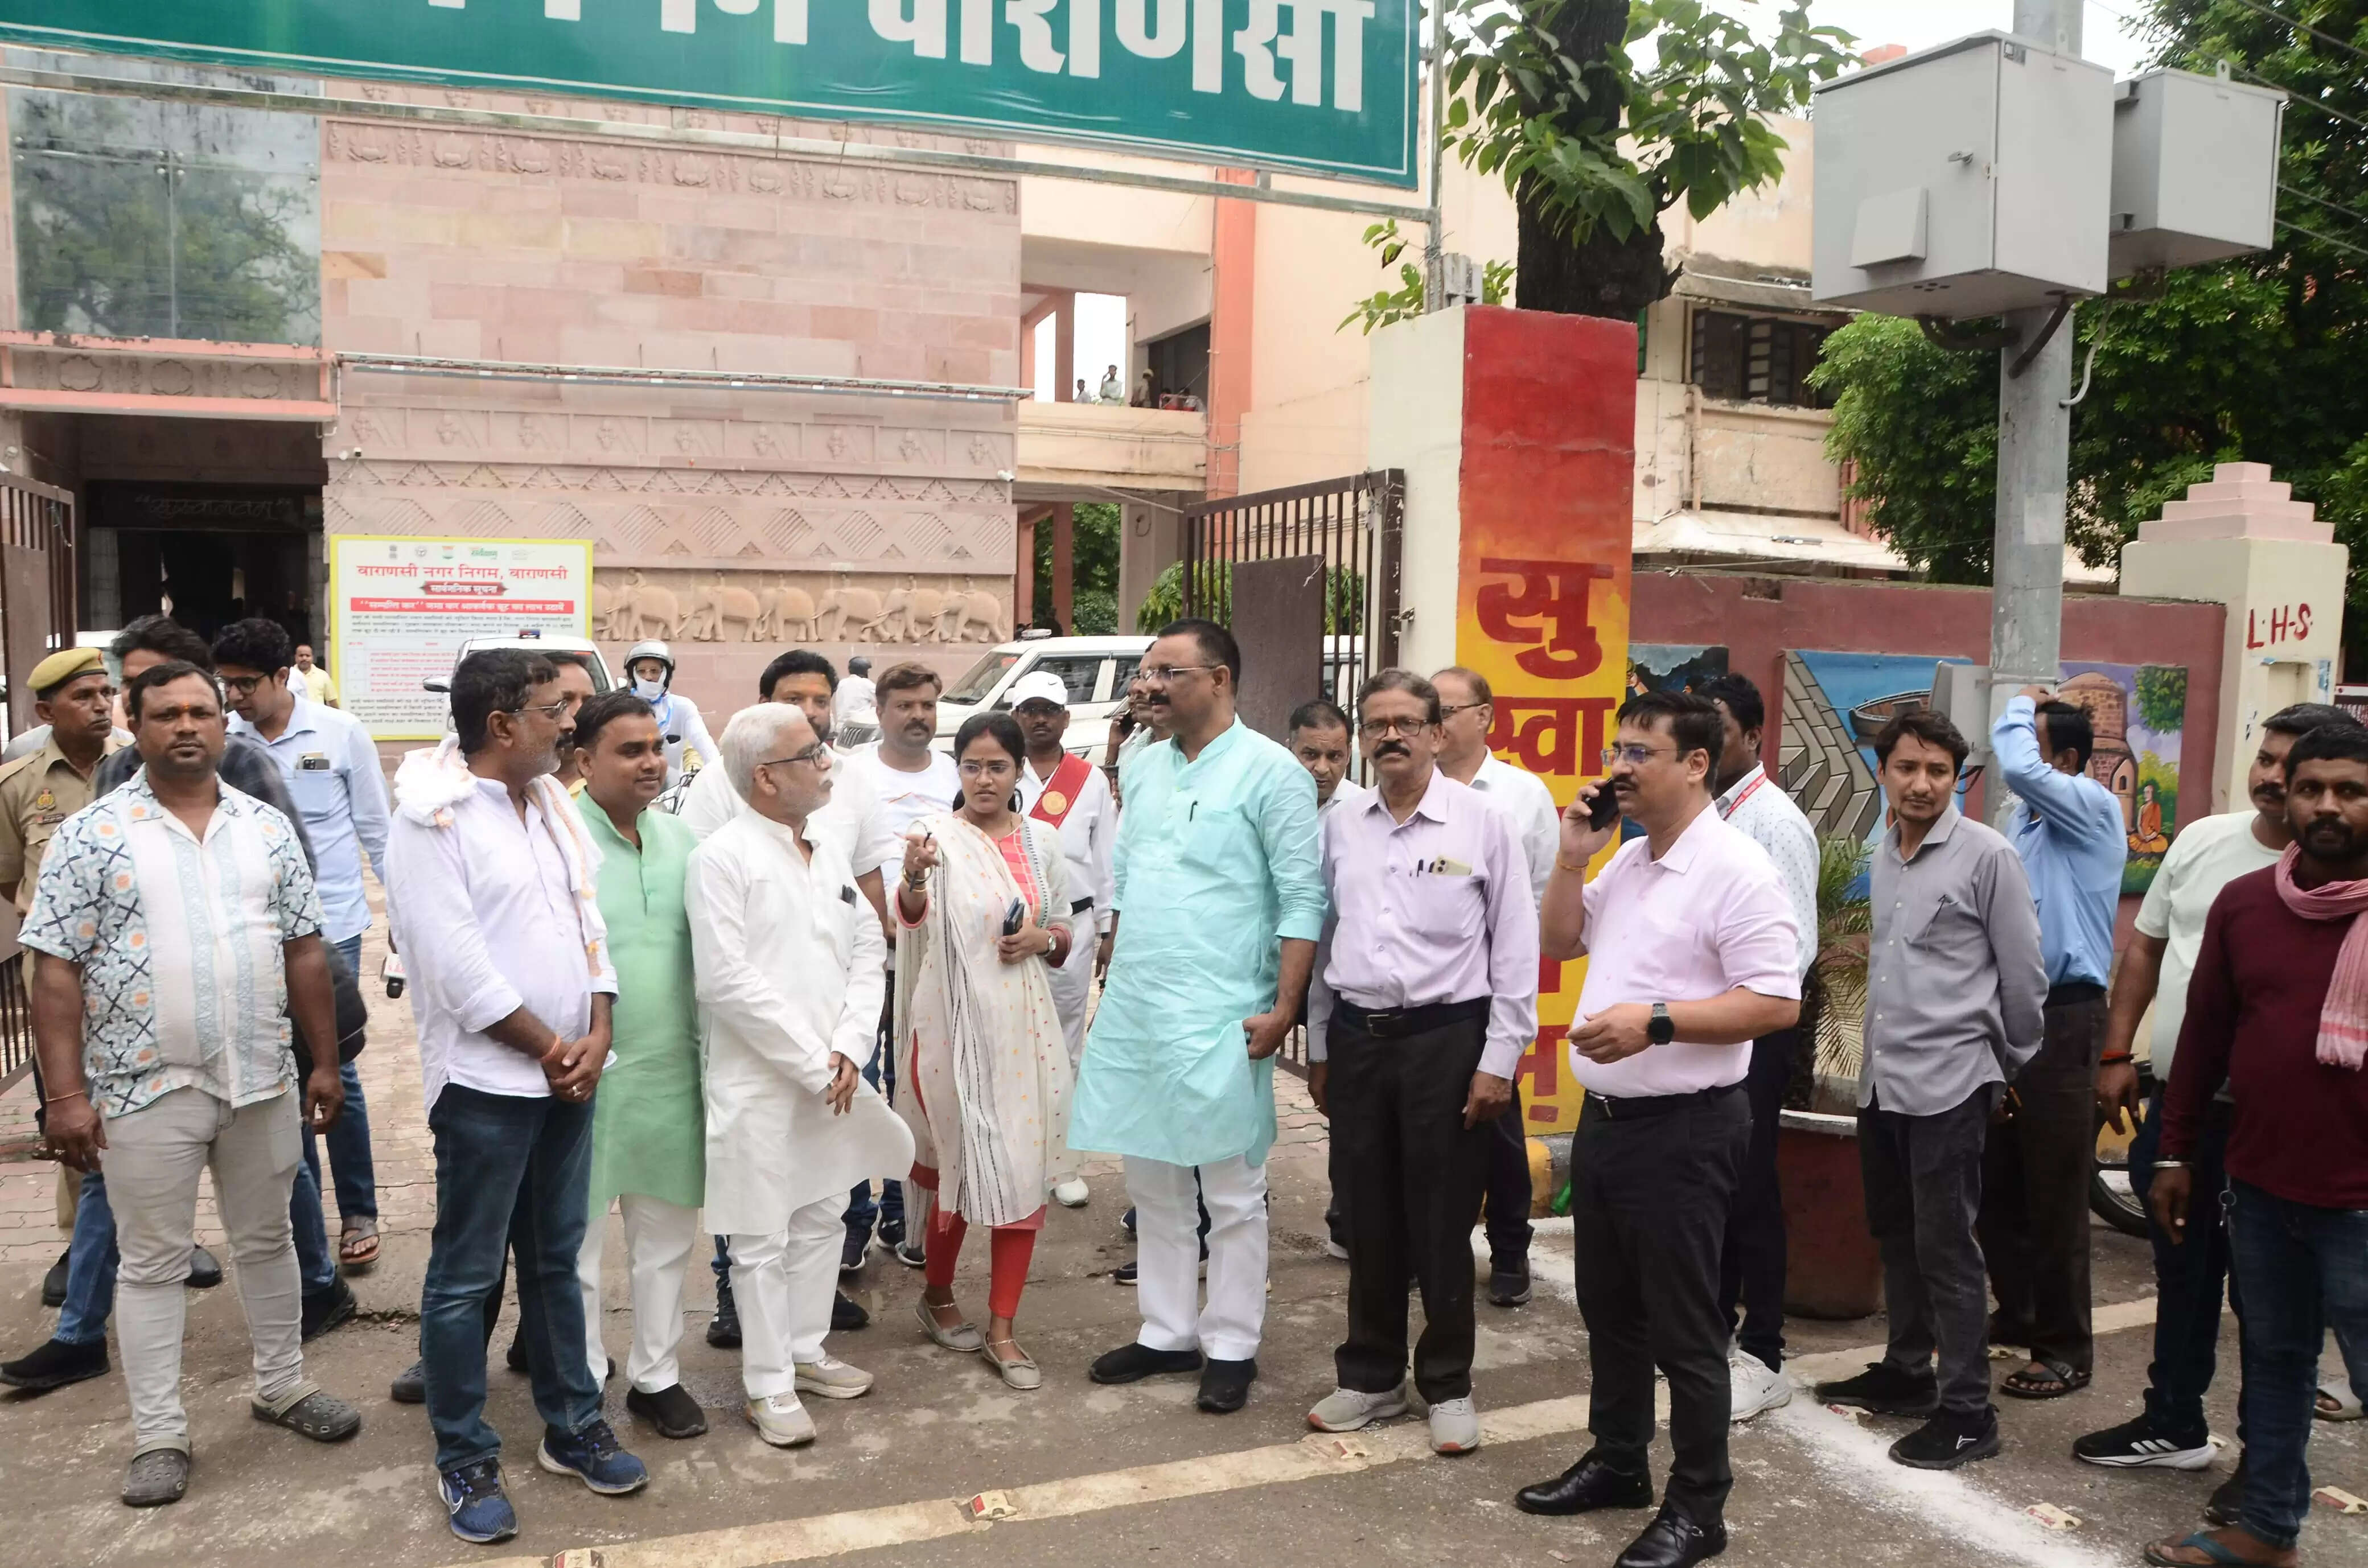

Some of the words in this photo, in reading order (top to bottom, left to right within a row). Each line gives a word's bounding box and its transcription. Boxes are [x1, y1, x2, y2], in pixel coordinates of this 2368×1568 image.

[356, 563, 418, 577] वाराणसी
[423, 567, 454, 578] नगर
[459, 563, 503, 579] निगम,
[509, 566, 569, 579] वाराणसी
